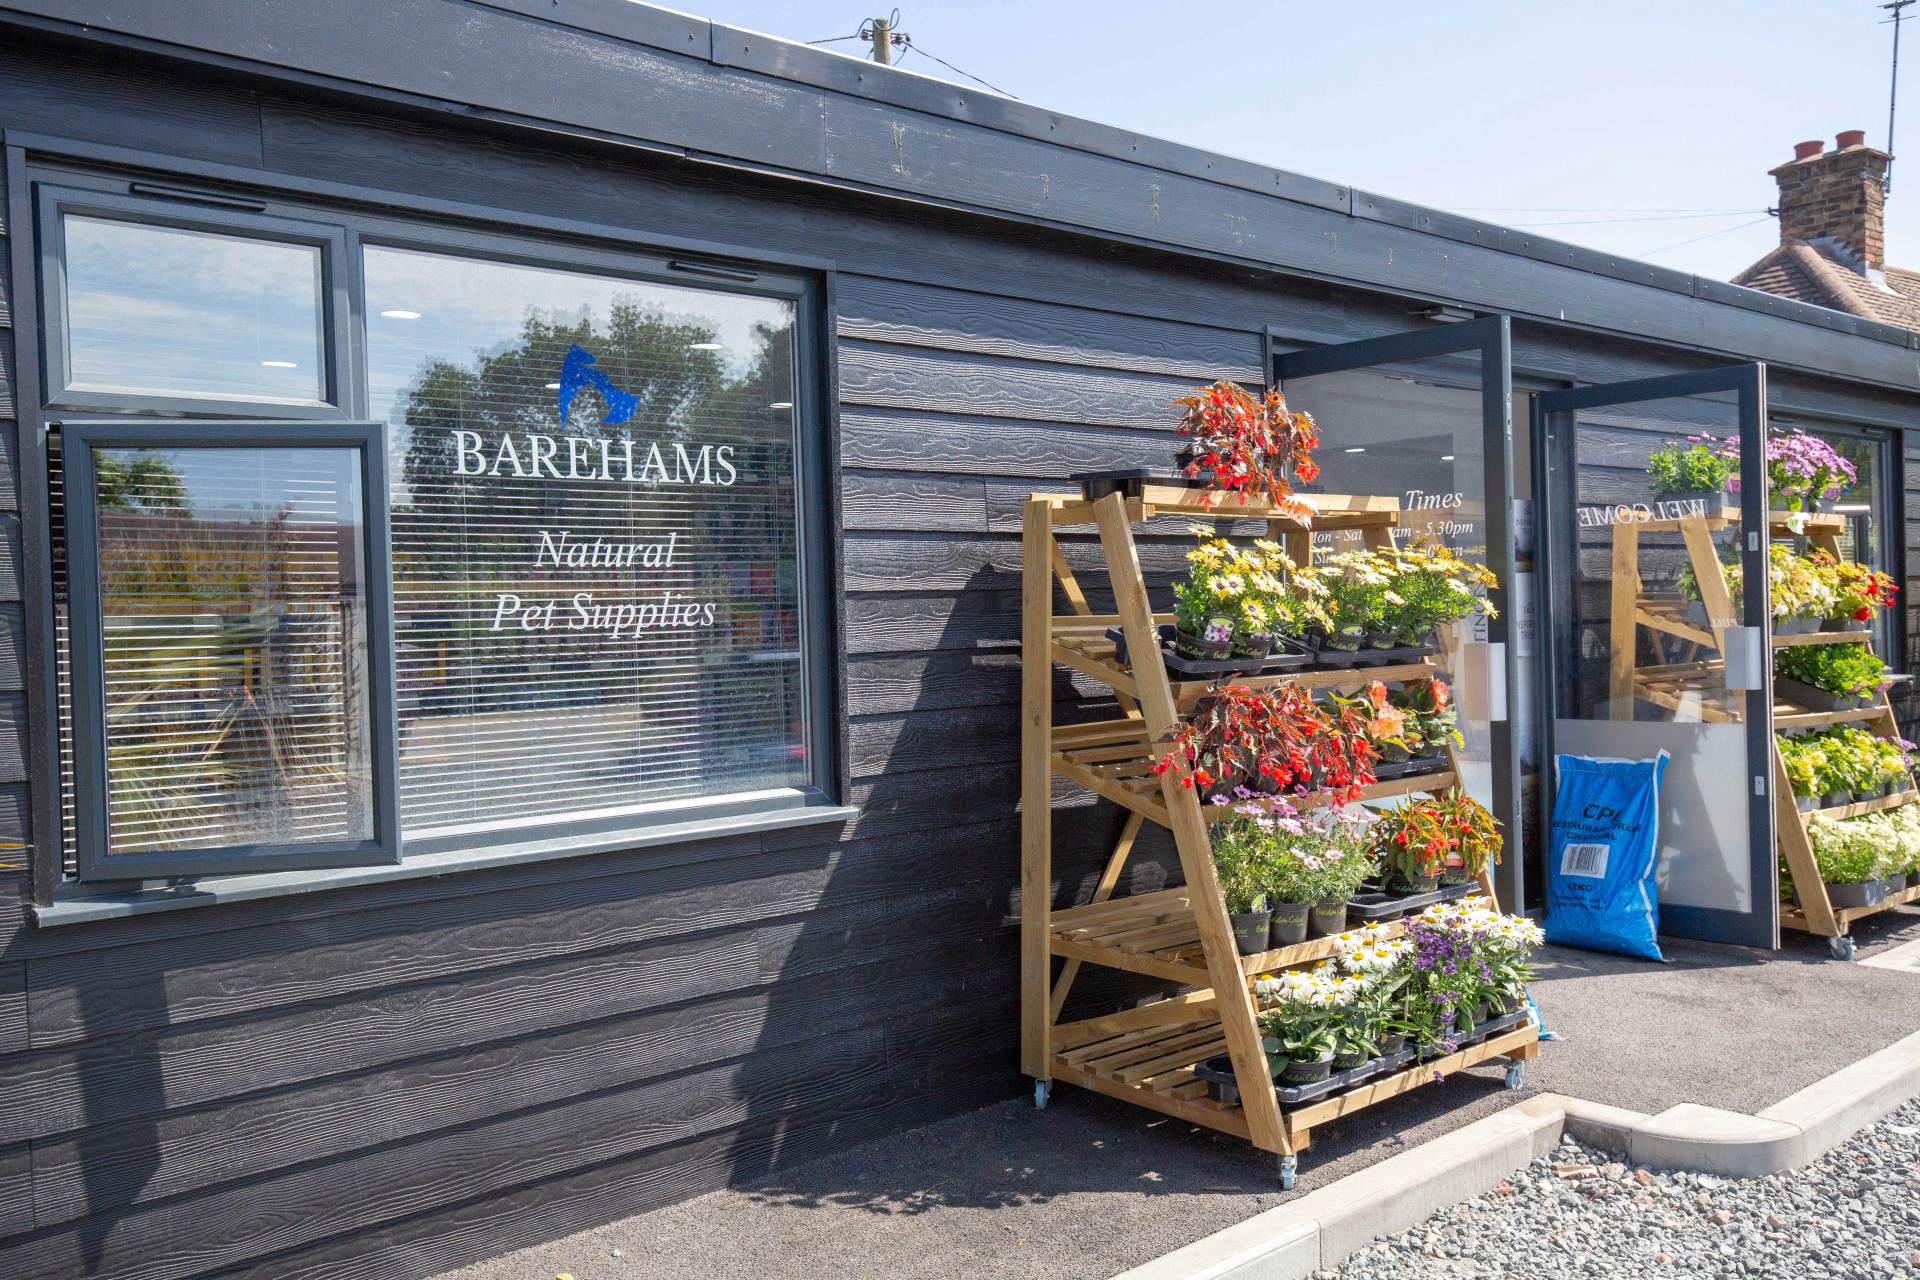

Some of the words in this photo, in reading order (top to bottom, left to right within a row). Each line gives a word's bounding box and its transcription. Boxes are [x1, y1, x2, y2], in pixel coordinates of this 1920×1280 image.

[451, 430, 737, 487] BAREHAMS
[1406, 489, 1463, 511] Times
[533, 529, 677, 568] Natural
[1426, 521, 1474, 538] 5.30pm
[490, 594, 556, 631] Pet
[569, 591, 716, 639] Supplies
